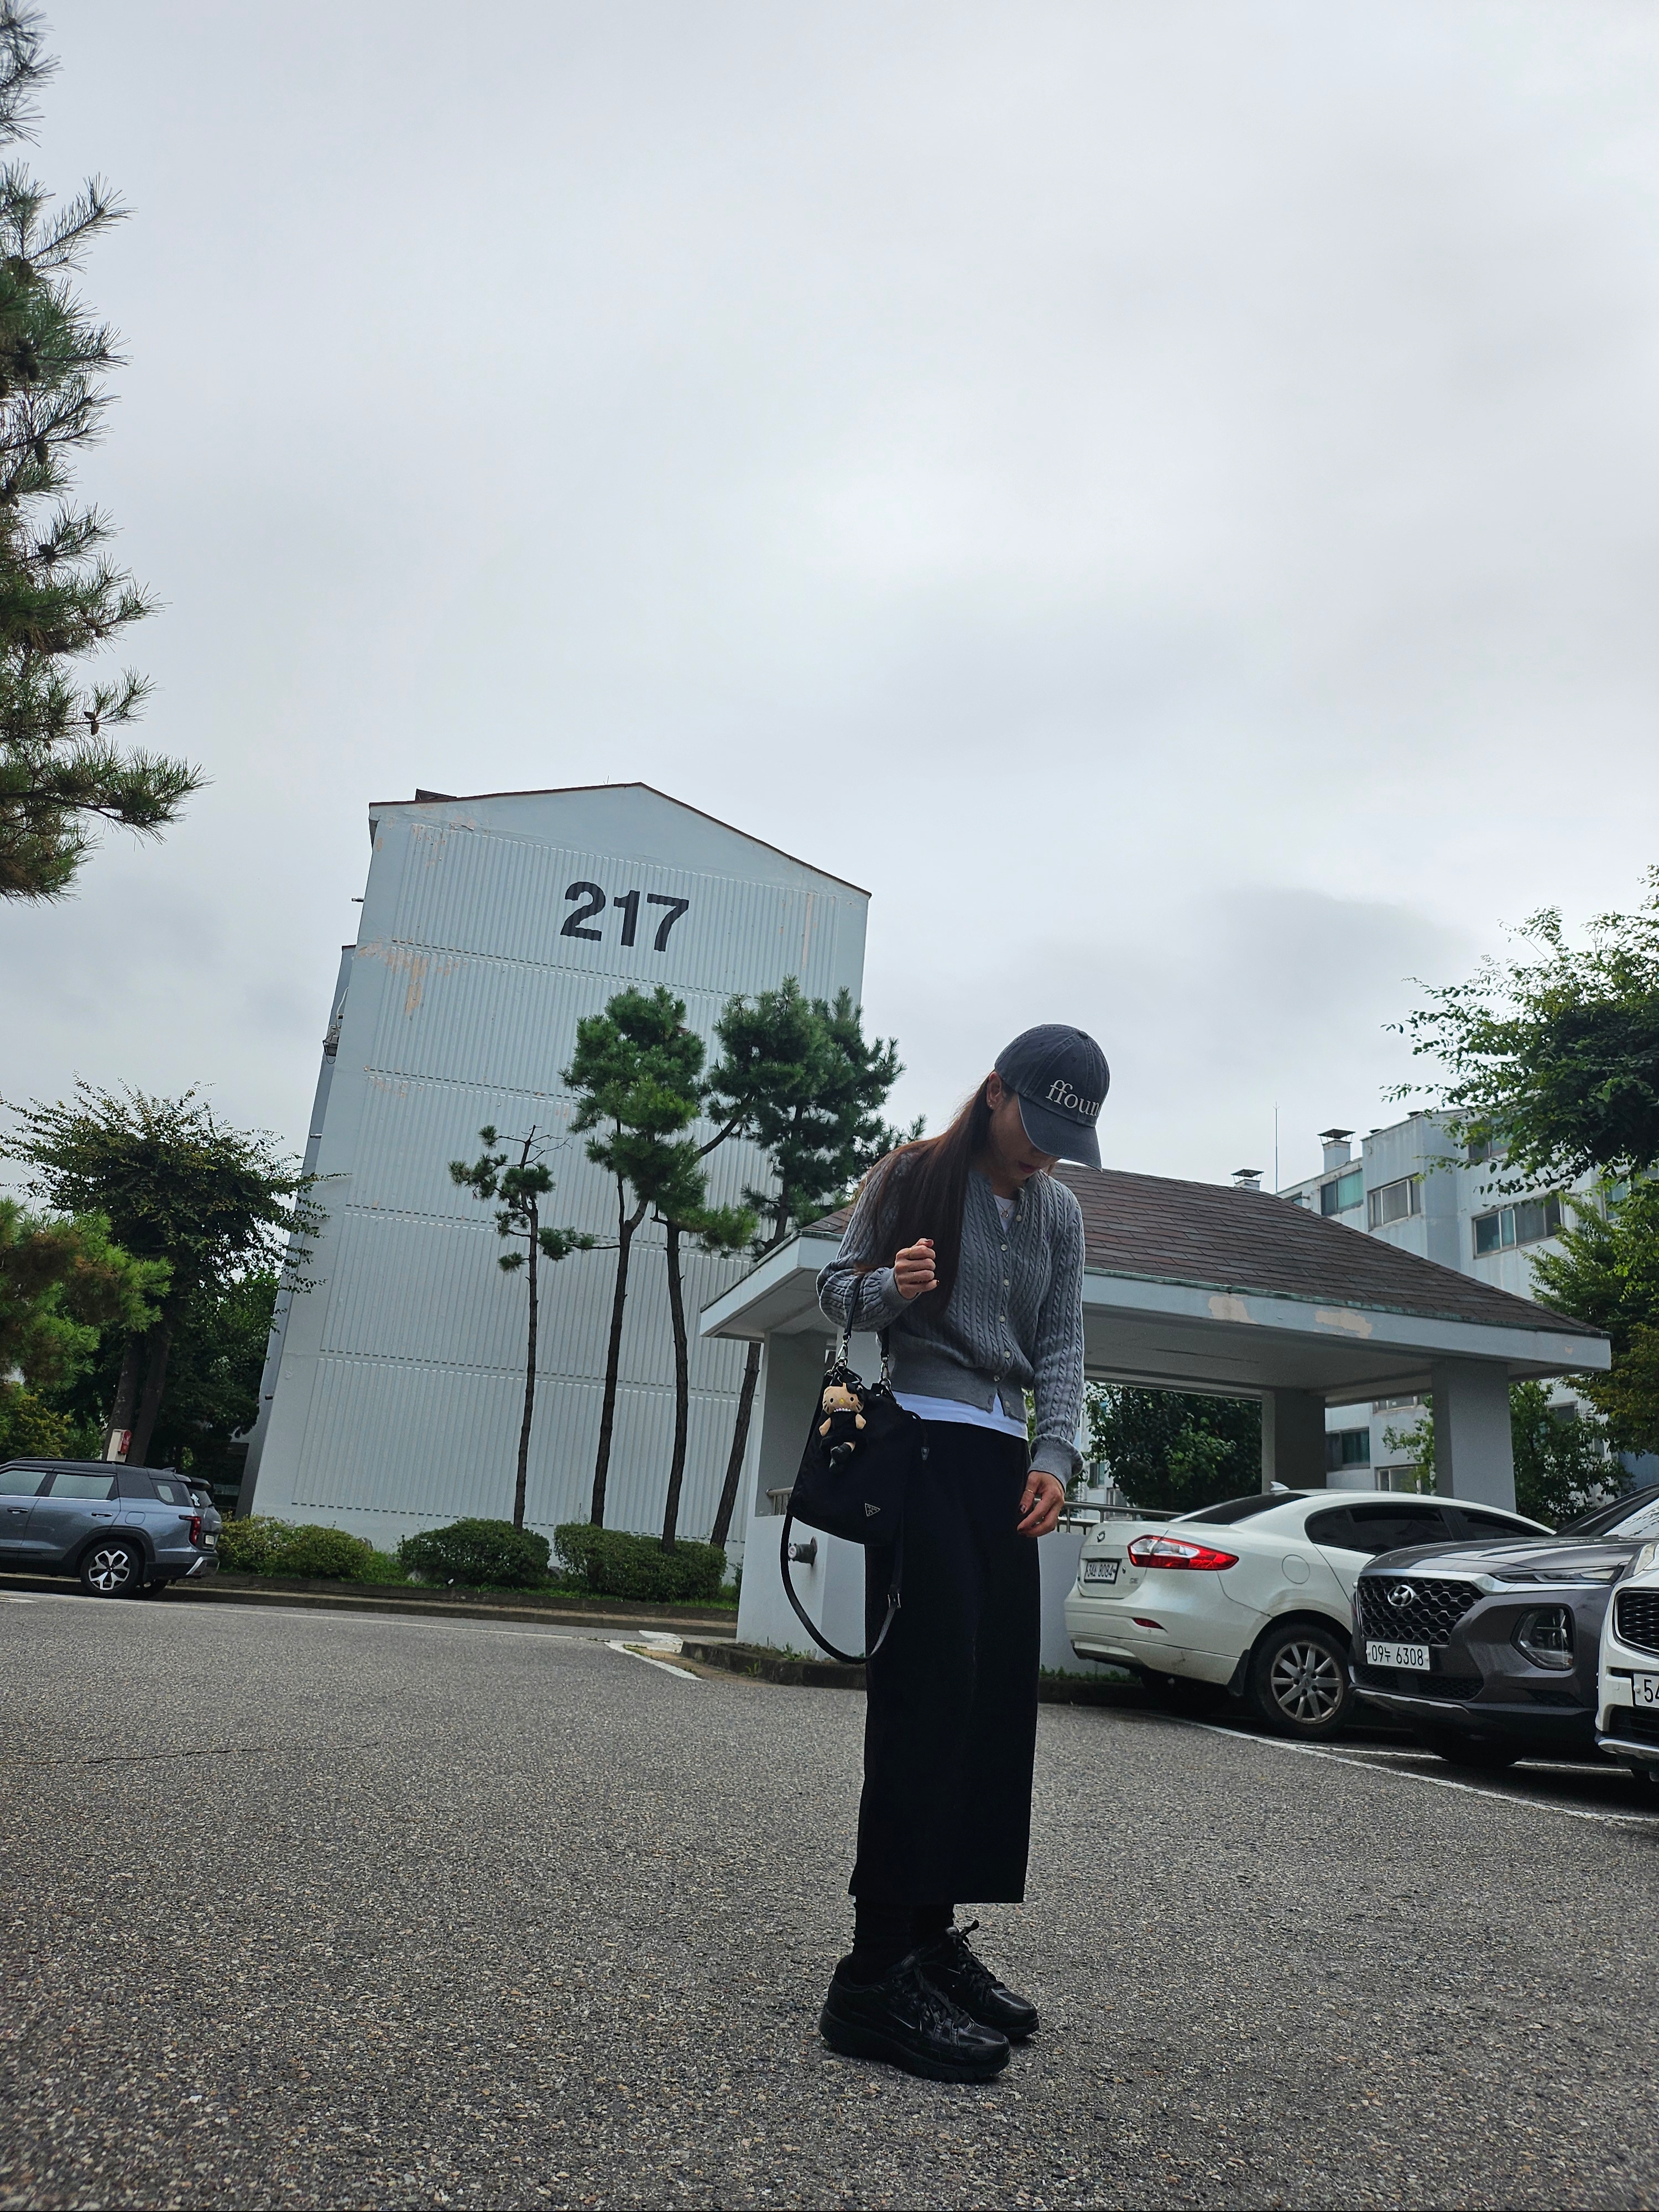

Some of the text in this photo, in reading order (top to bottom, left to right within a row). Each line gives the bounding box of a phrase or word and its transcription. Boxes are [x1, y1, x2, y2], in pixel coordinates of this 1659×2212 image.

[560, 881, 690, 952] 217
[1098, 1564, 1114, 1577] 8084
[1372, 1645, 1423, 1666] 09누 6308
